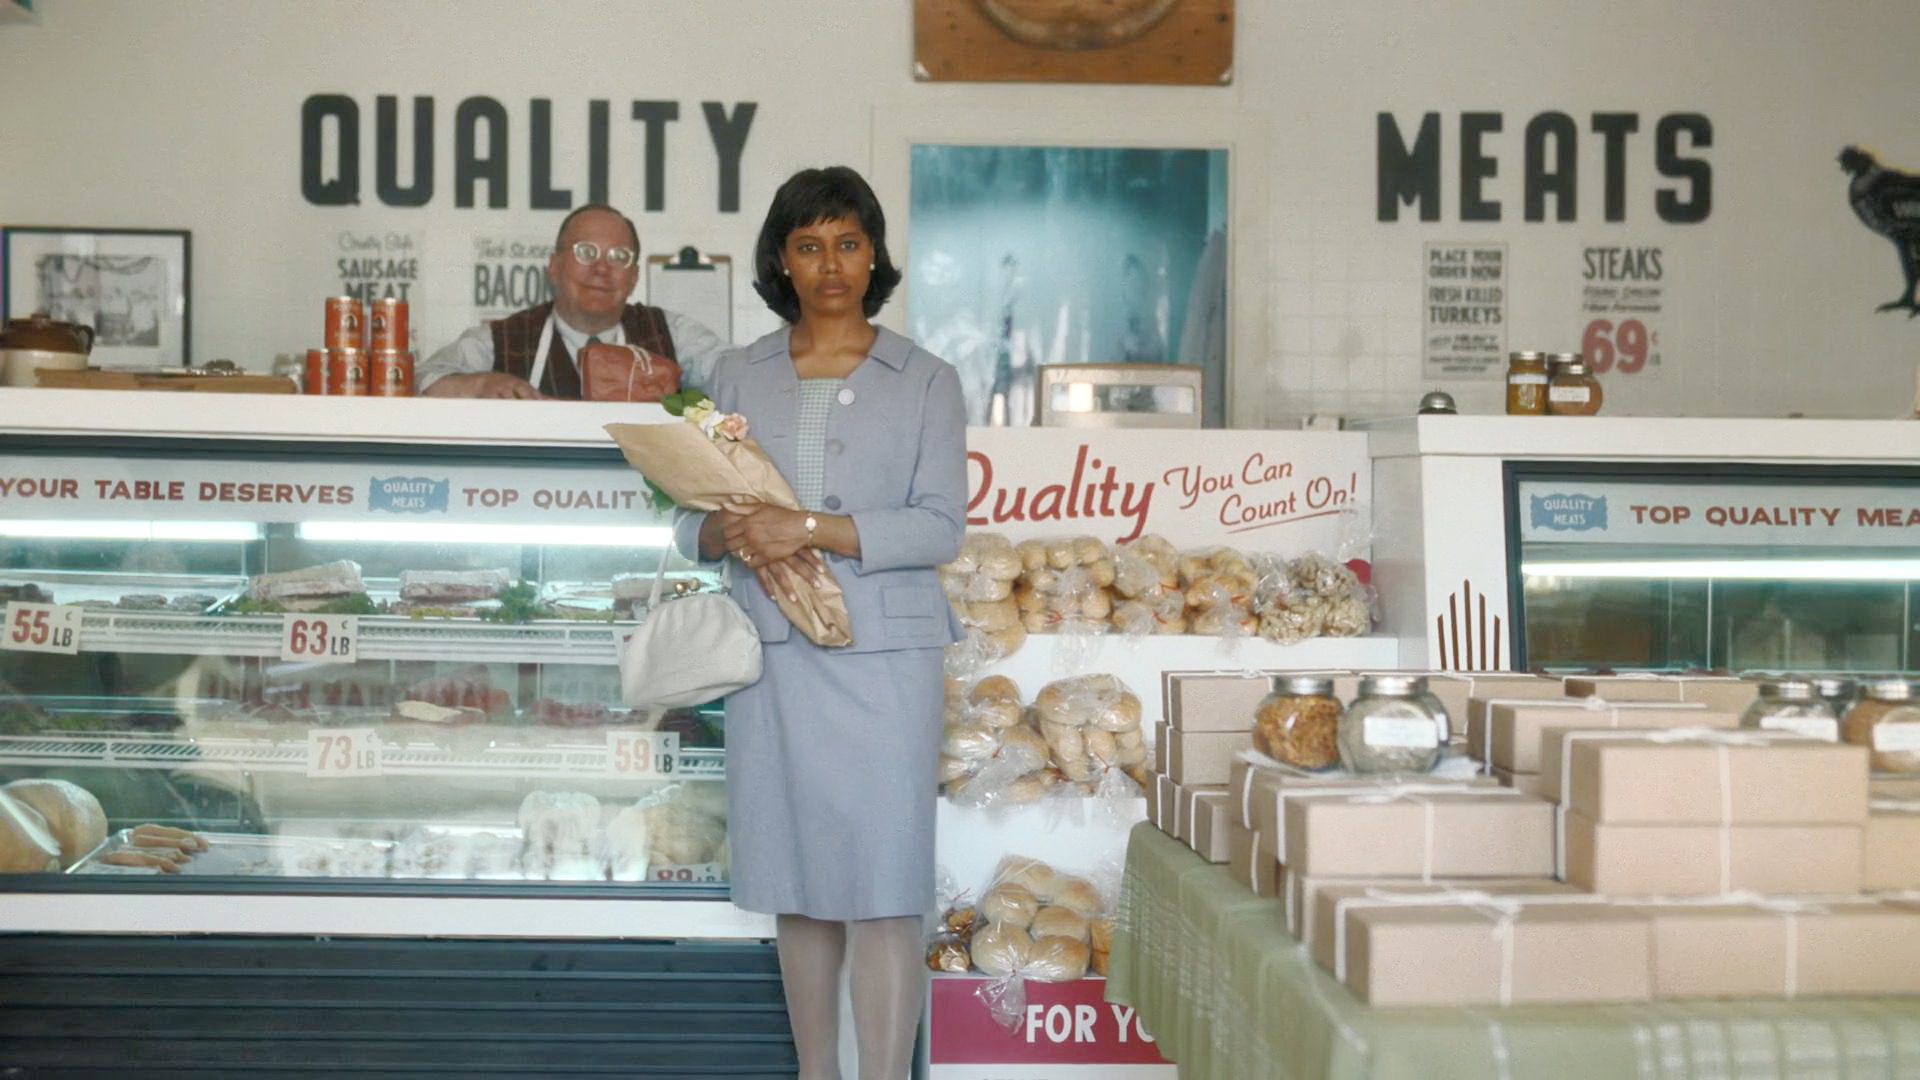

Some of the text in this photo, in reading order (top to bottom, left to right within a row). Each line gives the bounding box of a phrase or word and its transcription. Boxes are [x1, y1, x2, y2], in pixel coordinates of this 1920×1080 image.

[301, 93, 758, 213] QUALITY
[1376, 111, 1713, 224] MEATS
[337, 257, 418, 279] SAUSAGE
[1583, 248, 1662, 280] STEAKS
[345, 282, 411, 305] MEAT
[1430, 305, 1503, 325] TURKEYS
[1582, 319, 1648, 374] 69
[0, 478, 354, 505] YOUR TABLE DESERVES
[383, 482, 436, 494] QUALITY
[1163, 452, 1293, 510] You Can
[391, 496, 426, 509] MEATS
[462, 488, 656, 510] TOP QUALITY
[1219, 472, 1357, 526] Count On!
[1544, 499, 1594, 511] QUALITY
[1553, 513, 1586, 525] MEATS
[1630, 505, 1691, 524] TOP
[1705, 506, 1840, 527] QUALITY
[12, 609, 49, 645] 55
[52, 627, 73, 647] LB
[290, 619, 328, 655] 63
[331, 636, 350, 655] LB
[316, 736, 352, 769] 73
[357, 750, 375, 769] LB
[614, 738, 649, 772] 59
[655, 753, 673, 773] LB
[1026, 1004, 1097, 1043] FOR
